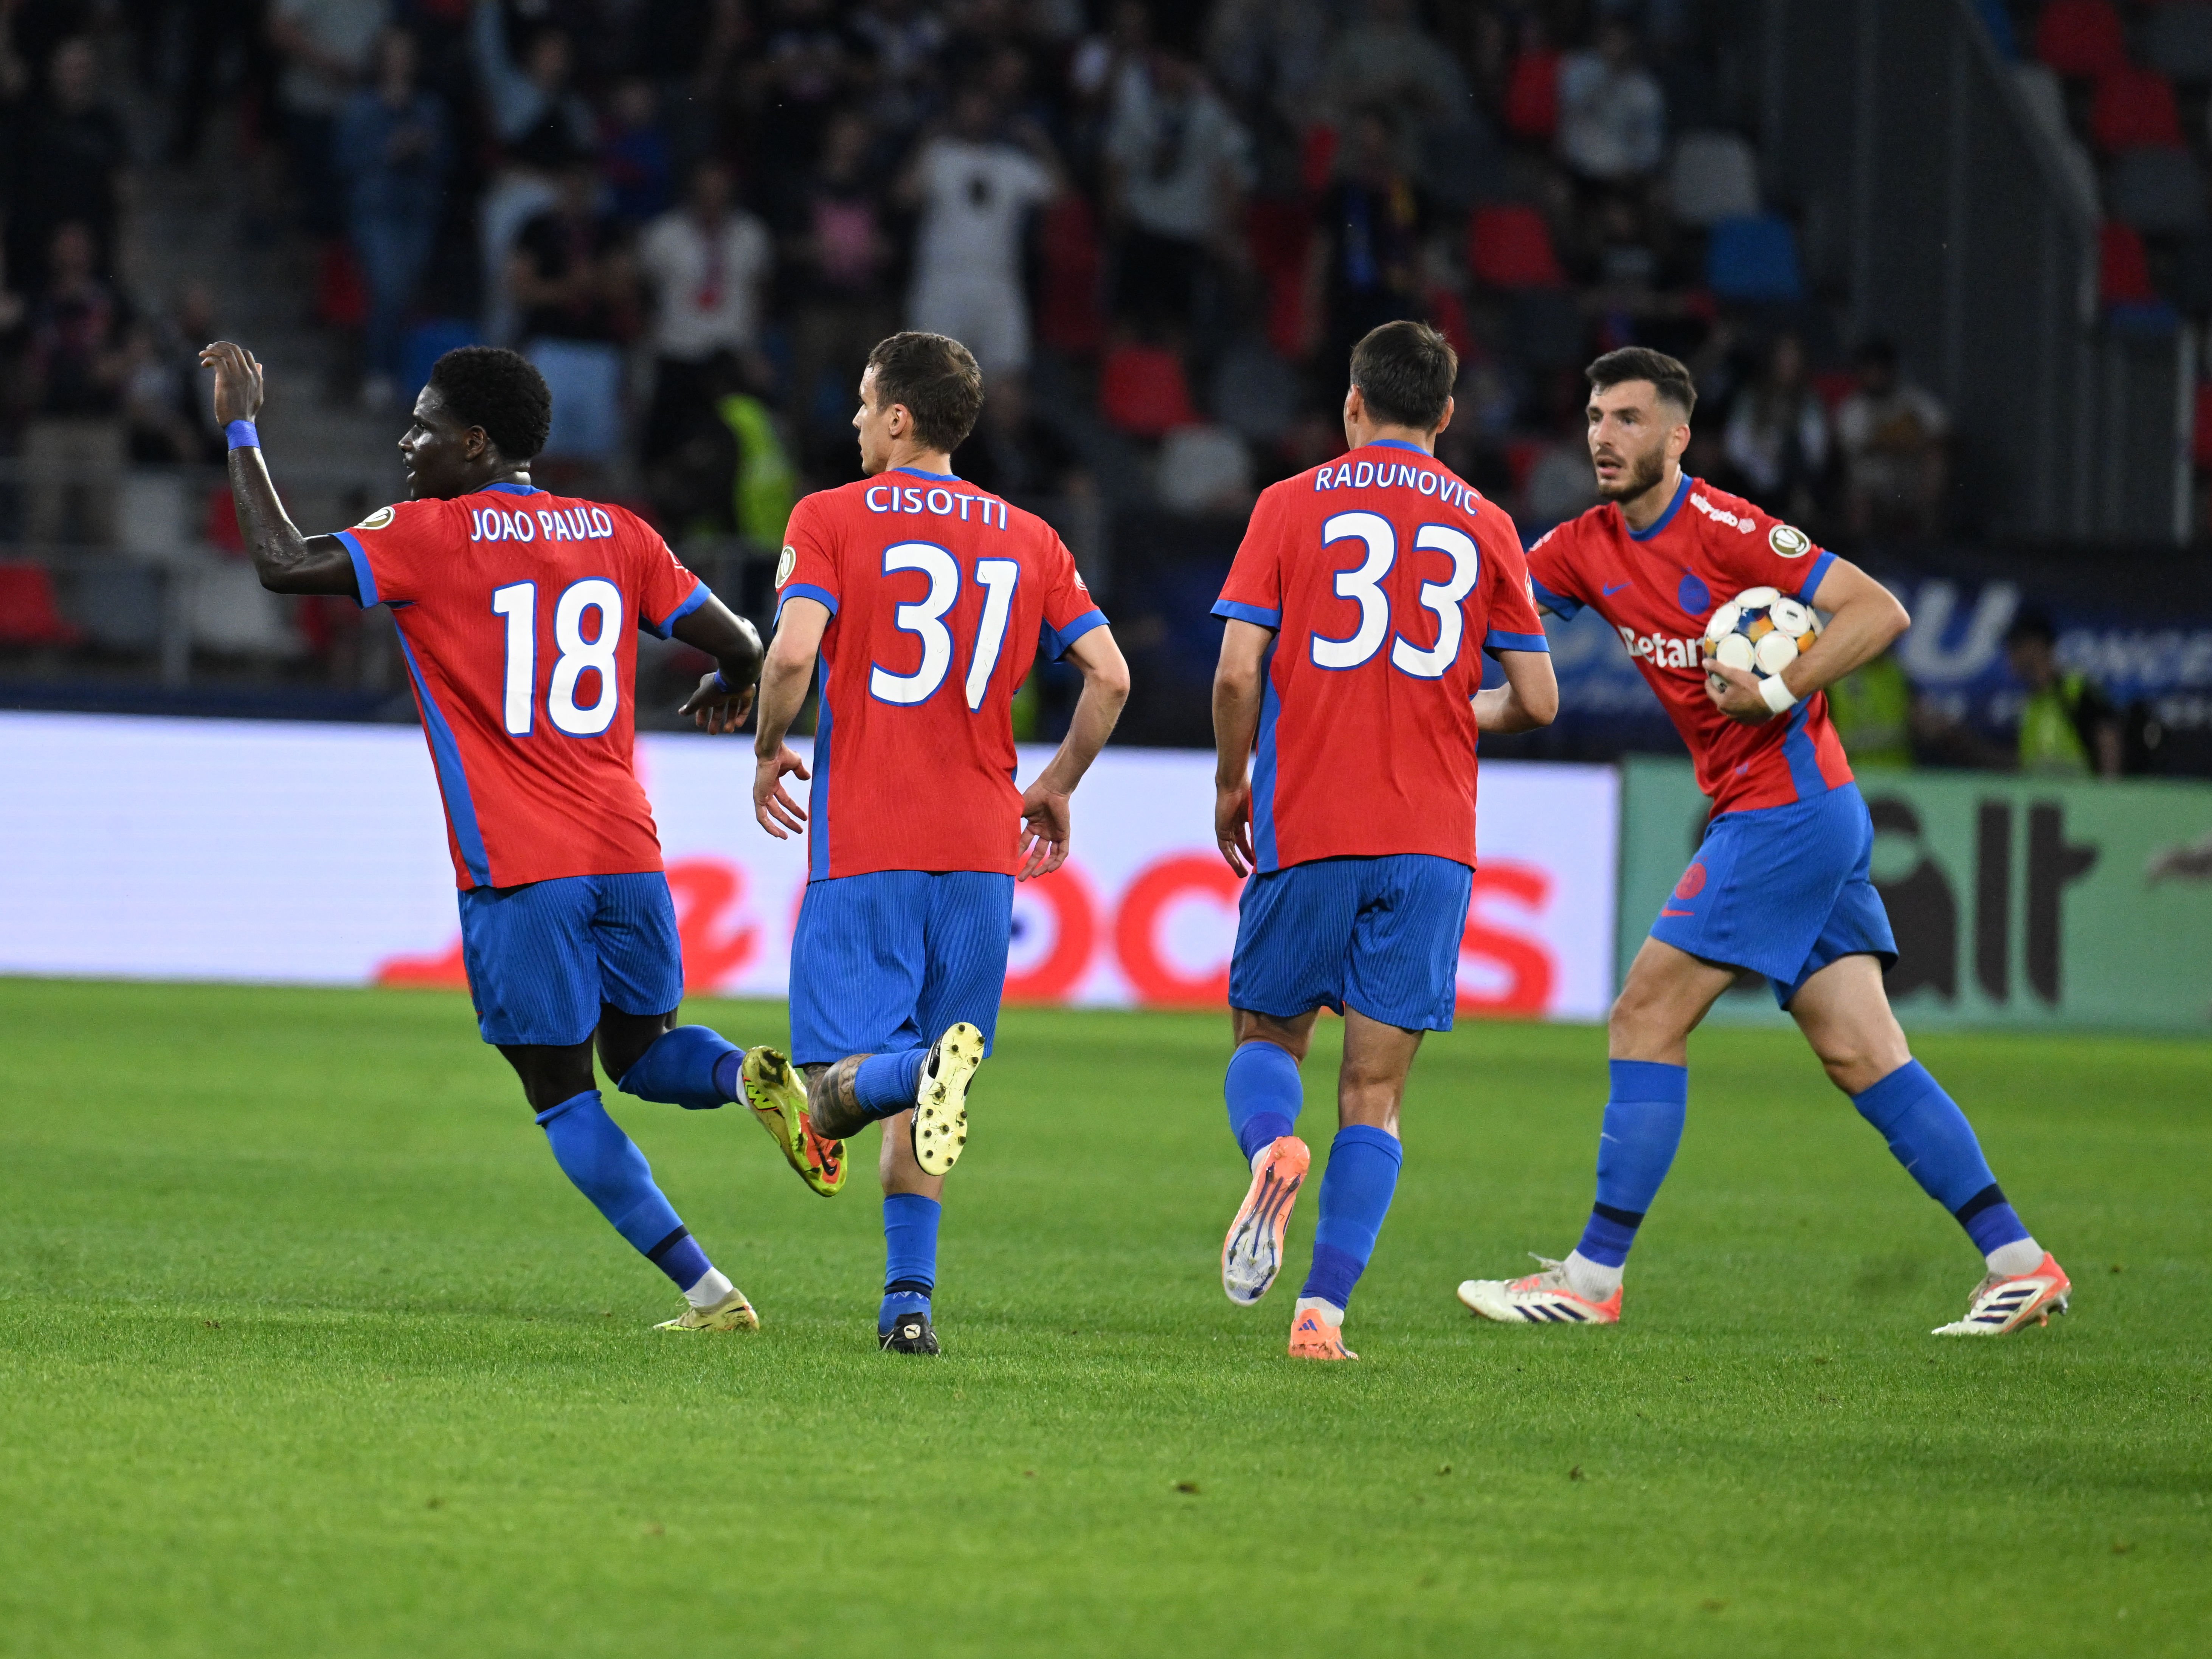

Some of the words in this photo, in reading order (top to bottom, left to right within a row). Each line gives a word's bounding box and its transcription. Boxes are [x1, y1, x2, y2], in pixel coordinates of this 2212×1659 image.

[865, 485, 1007, 530] CISOTTI
[1315, 461, 1480, 516] RADUNOVIC
[470, 508, 535, 543] JOAO
[536, 507, 613, 541] PAULO
[1310, 510, 1480, 680] 33
[869, 540, 1020, 713] 31
[1618, 625, 1705, 668] Betan
[491, 576, 624, 739] 18
